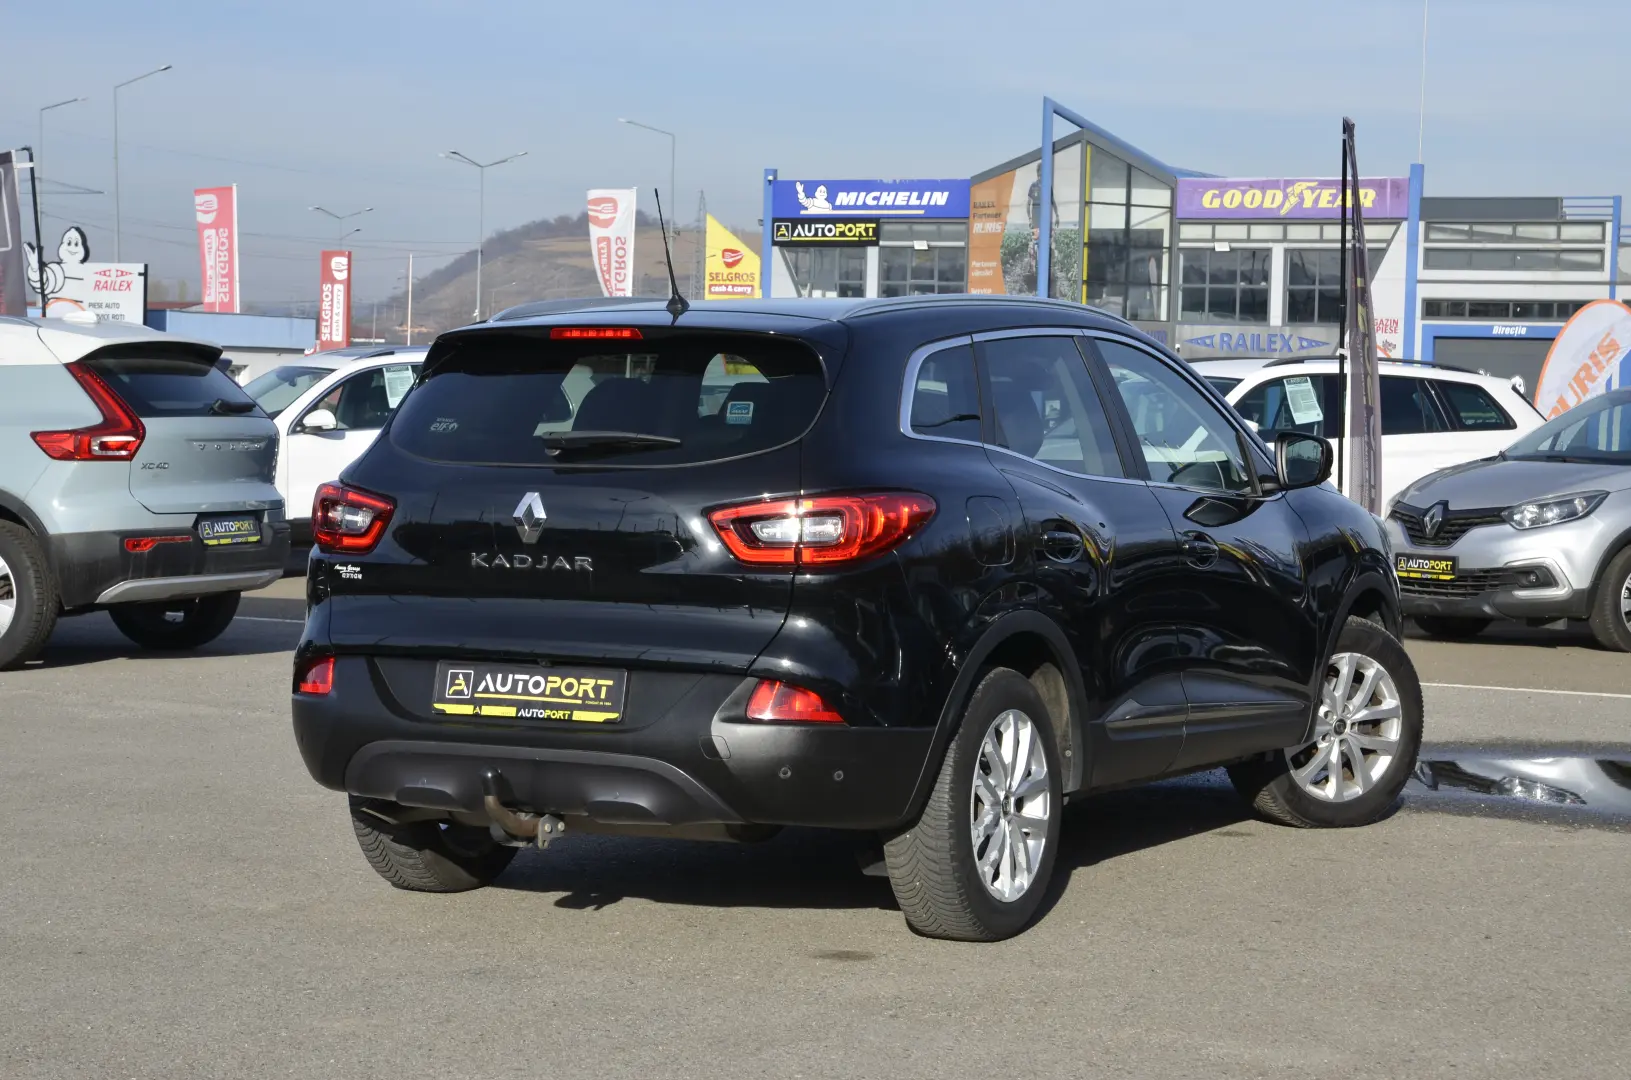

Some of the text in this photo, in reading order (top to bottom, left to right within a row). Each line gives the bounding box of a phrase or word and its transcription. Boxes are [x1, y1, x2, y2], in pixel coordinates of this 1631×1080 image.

[835, 191, 949, 206] MICHELIN
[1202, 188, 1284, 209] GOOD
[793, 223, 876, 237] AUTOPORT
[708, 272, 756, 283] SELGROS
[92, 280, 133, 292] RAILEX
[711, 285, 728, 293] cash
[733, 286, 752, 294] carry
[322, 283, 332, 342] SELGROS
[1376, 326, 1400, 334] PIESE
[1219, 332, 1294, 353] RAILEX
[213, 520, 254, 533] AUTOPORT
[471, 552, 594, 571] KADJAR
[1407, 558, 1453, 571] AUTOPORT
[477, 672, 614, 700] AUTOPORT
[518, 708, 571, 720] AUTOPORT
